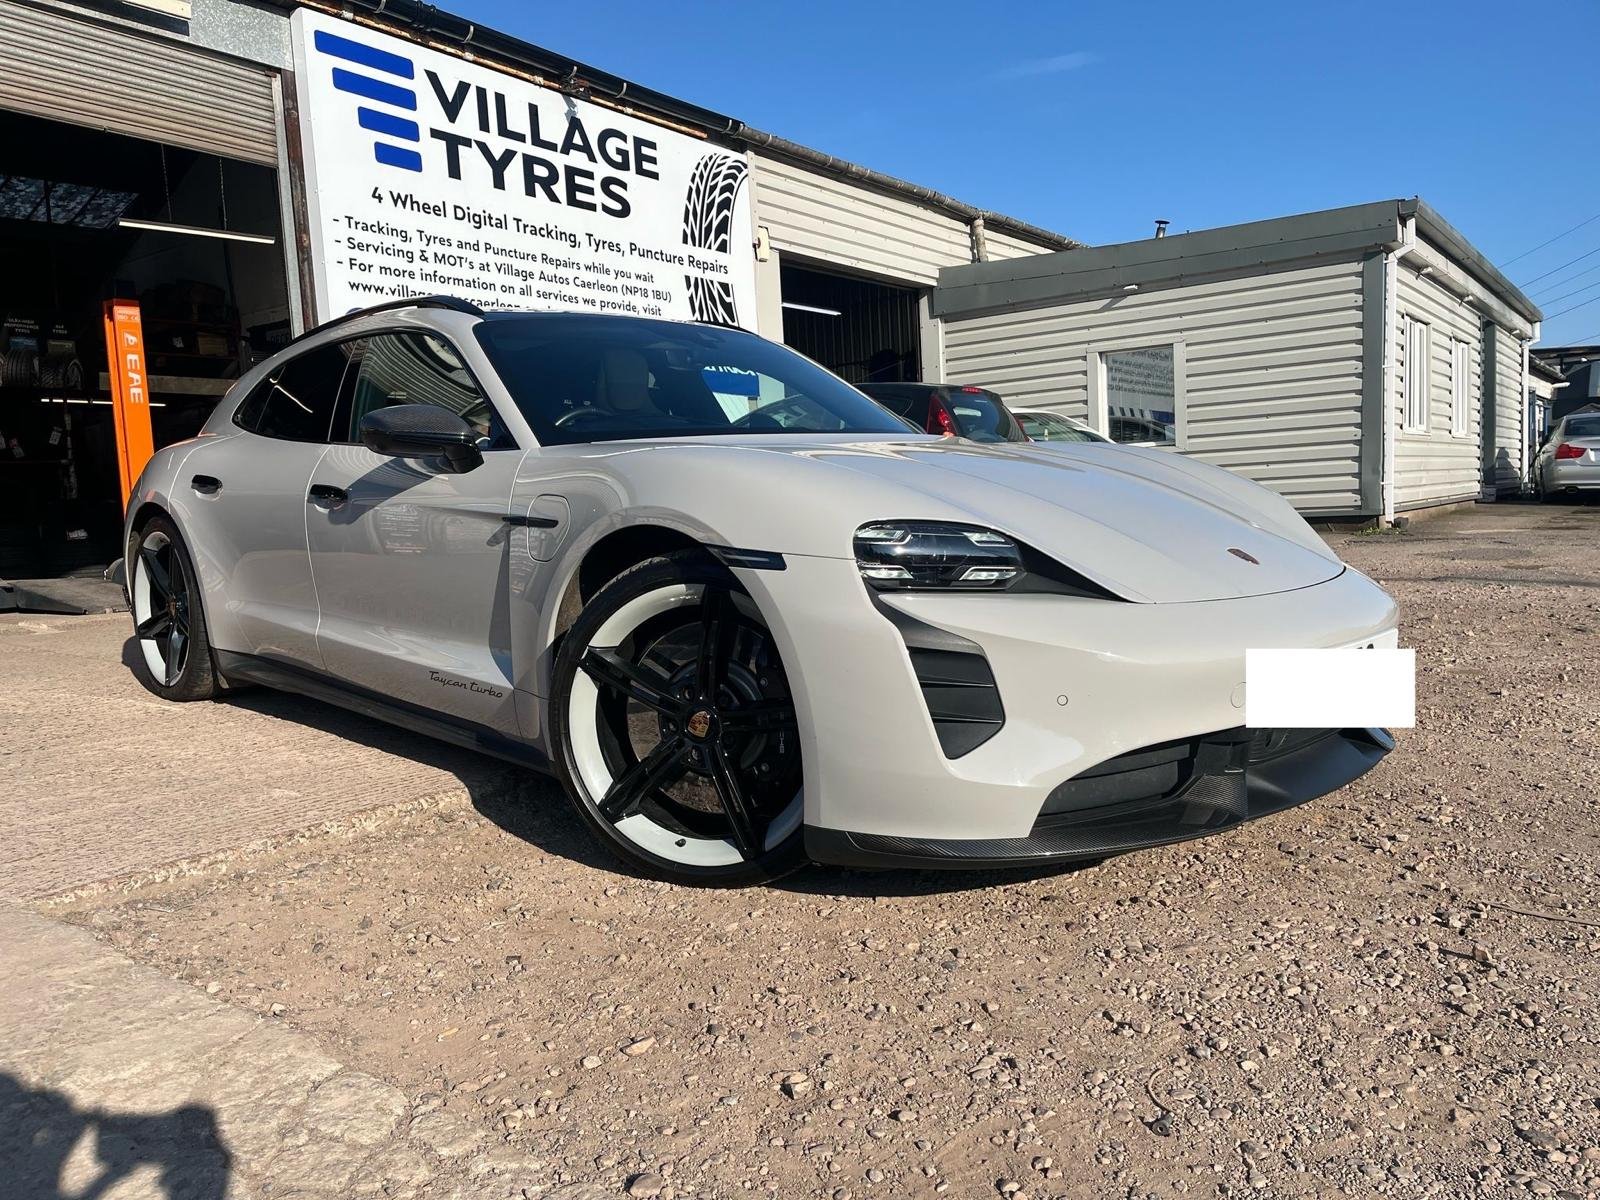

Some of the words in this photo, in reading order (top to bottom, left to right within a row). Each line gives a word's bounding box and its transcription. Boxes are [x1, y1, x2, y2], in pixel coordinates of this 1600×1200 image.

[424, 69, 660, 181] VILLAGE
[429, 127, 631, 218] TYRES
[344, 215, 413, 243] Tracking,
[416, 229, 452, 247] Tyres
[456, 239, 480, 252] and
[484, 242, 538, 262] Puncture
[541, 253, 581, 271] Repairs
[584, 261, 611, 276] while
[613, 268, 632, 280] you
[634, 271, 654, 284] wait
[371, 187, 383, 203] 4
[389, 190, 447, 218] Wheel
[453, 205, 508, 230] Digital
[512, 217, 581, 248] Tracking,
[585, 233, 625, 257] Tyres,
[629, 242, 684, 265] Puncture
[688, 255, 729, 274] Repairs
[347, 237, 414, 263] Servicing
[419, 249, 429, 263] &
[434, 252, 474, 270] MOT's
[478, 260, 491, 272] at
[494, 262, 535, 282] Village
[538, 271, 570, 286] Autos
[573, 277, 618, 294] Caerleon
[621, 284, 649, 299] (NP18
[652, 287, 672, 303] 1BU)
[349, 257, 374, 273] For
[379, 265, 416, 280] more
[420, 268, 497, 292] information
[500, 282, 515, 294] on
[519, 284, 533, 297] all
[536, 287, 579, 304] services
[582, 297, 596, 307] we
[600, 298, 640, 315] provide,
[642, 305, 661, 316] visit
[126, 353, 143, 404] EAE
[429, 671, 467, 689] Taycan
[470, 681, 503, 698] turbo
